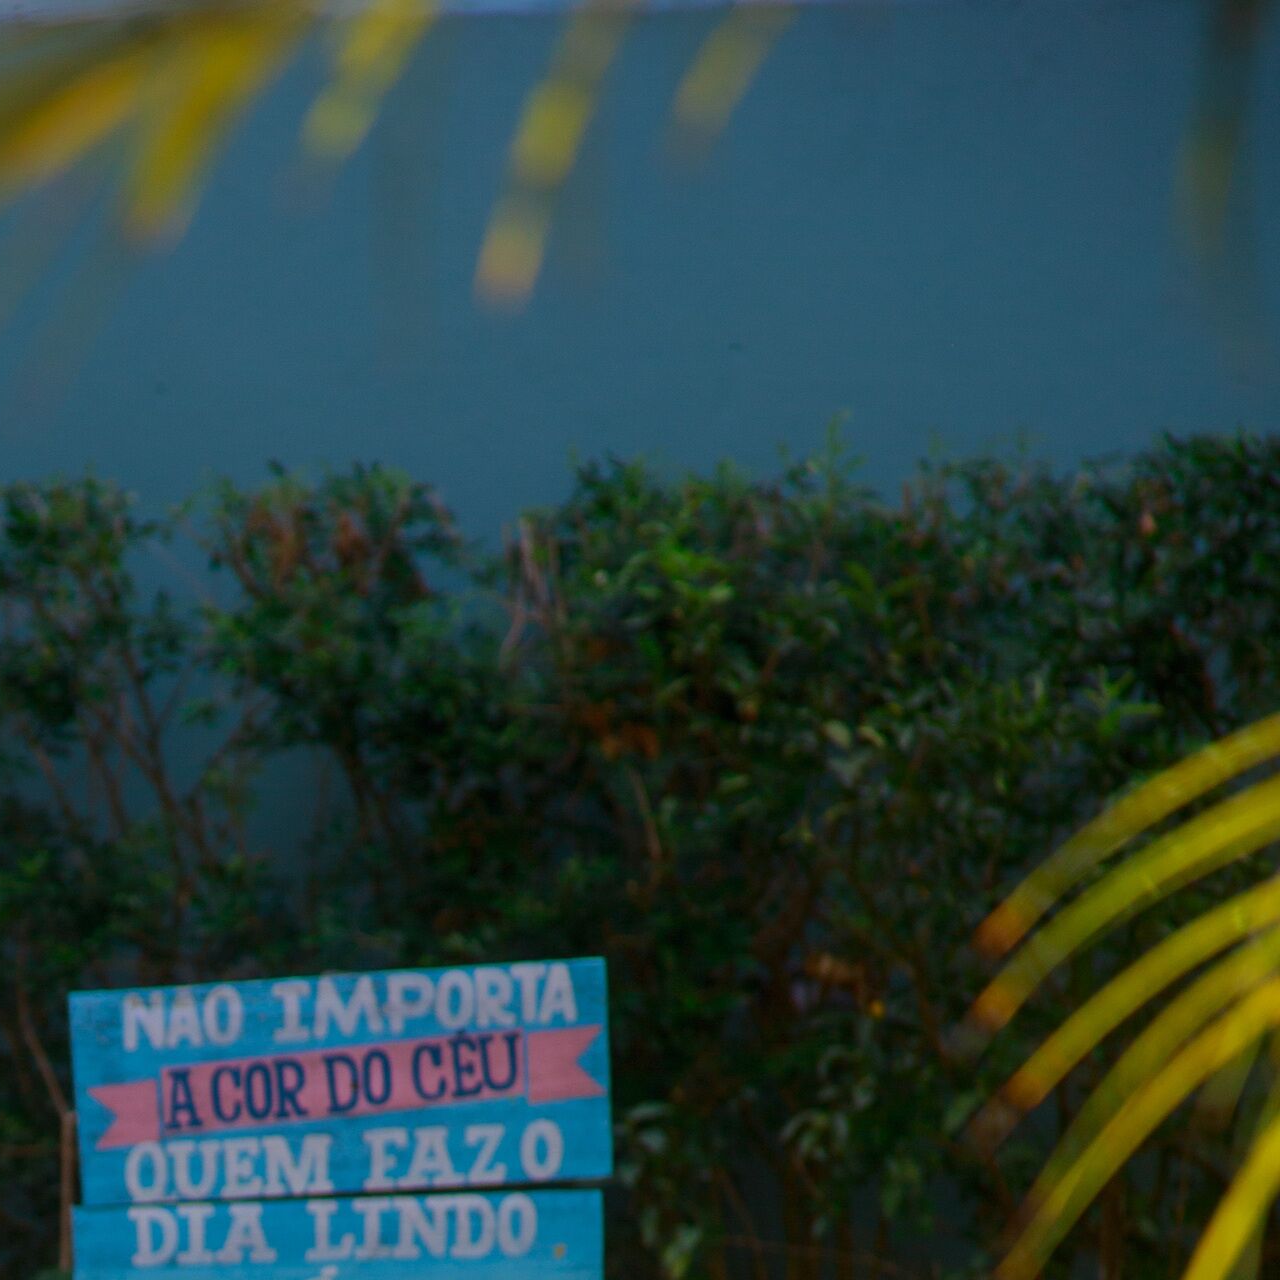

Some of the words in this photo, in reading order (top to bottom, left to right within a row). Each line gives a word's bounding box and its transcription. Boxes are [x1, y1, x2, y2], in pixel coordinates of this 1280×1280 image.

[273, 964, 577, 1042] IMPORTA
[164, 1072, 202, 1130] A
[210, 1058, 307, 1122] COR
[324, 1050, 392, 1116] DO
[412, 1031, 522, 1100] CÉU
[125, 1134, 333, 1202] QUEM
[363, 1124, 506, 1191] FAZ
[522, 1118, 563, 1179] O
[128, 1203, 277, 1267] DIA
[305, 1193, 537, 1264] LINDO
